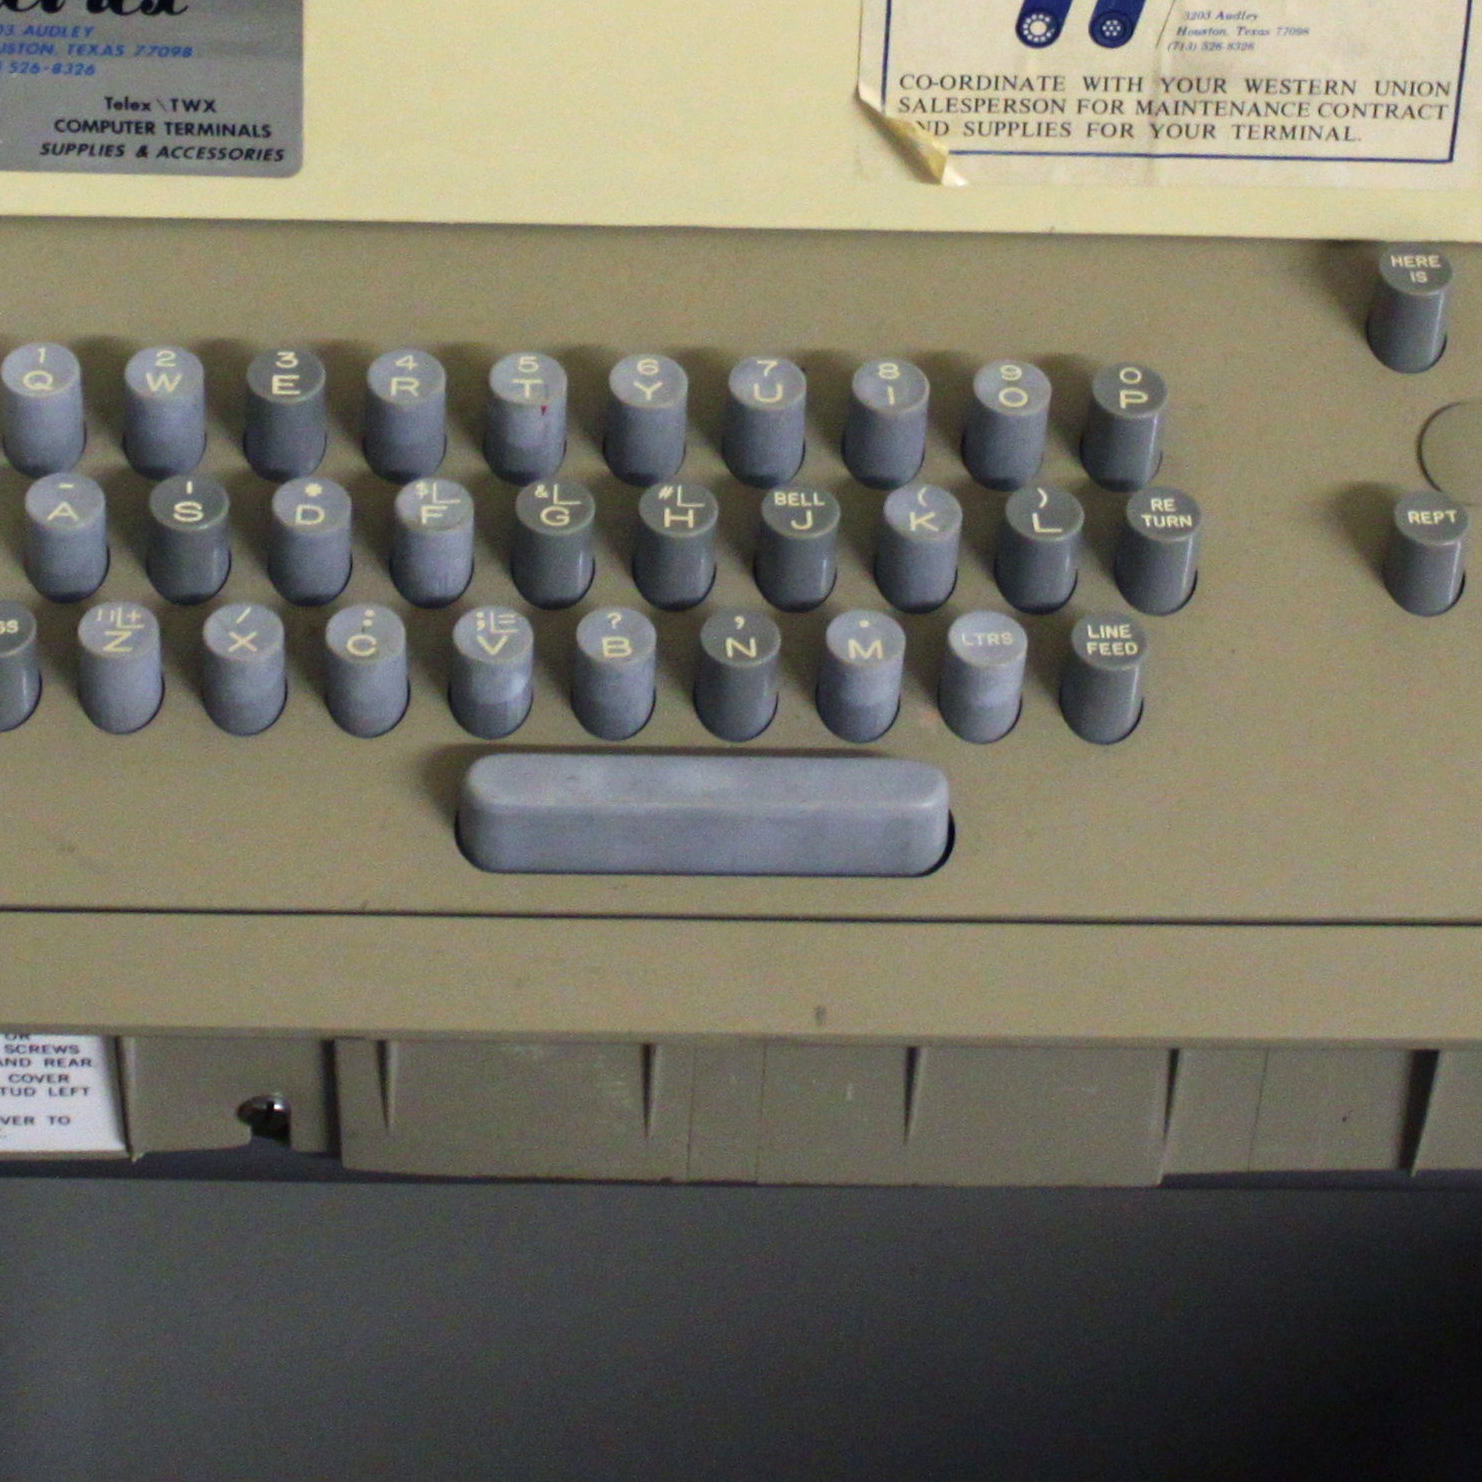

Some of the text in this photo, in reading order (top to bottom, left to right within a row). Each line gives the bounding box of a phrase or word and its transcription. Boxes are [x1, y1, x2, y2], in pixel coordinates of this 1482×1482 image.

[23, 25, 95, 39] AUDLEY
[1237, 26, 1270, 36] Texas
[68, 44, 125, 57] TEXAS
[135, 45, 193, 58] 77098
[10, 61, 95, 76] 526-8326
[899, 74, 1451, 97] CO-ORDINATE WITH YOUR WESTERN UNION
[105, 97, 152, 112] Telex
[899, 97, 1449, 119] SALESPERSON FOR MAINTENANCE CONTRACT
[55, 119, 271, 138] COMPUTER TERMINALS
[916, 120, 1362, 142] ND SUPPLIES FOR YOUR TERMINAL.
[40, 143, 284, 162] SUPPLIES & ACCESSORIES
[1391, 255, 1441, 268] HERE
[1410, 271, 1427, 283] IS
[38, 347, 46, 362] 1
[156, 351, 176, 367] 2
[276, 352, 297, 368] 3
[395, 355, 417, 370] 4
[519, 357, 538, 372] 5
[638, 359, 658, 375] 6
[757, 360, 777, 376] 7
[879, 364, 898, 379] 8
[1000, 365, 1022, 381] 9
[23, 372, 53, 389] Q
[145, 372, 182, 393] W
[272, 375, 300, 395] E
[390, 378, 420, 397] R
[513, 379, 543, 398] T
[633, 381, 663, 401] Y
[753, 384, 783, 403] U
[998, 388, 1028, 406] O
[1119, 390, 1148, 409] P
[774, 492, 824, 506] BELL
[1151, 498, 1175, 511] RE
[47, 502, 78, 521] A
[173, 502, 203, 521] S
[296, 505, 325, 525] D
[420, 506, 448, 525] F
[540, 507, 570, 526] G
[664, 509, 694, 529] H
[1407, 510, 1457, 524] REPT
[791, 511, 813, 530] J
[909, 512, 939, 531] K
[1032, 513, 1063, 533] L
[1141, 513, 1192, 528] TURN
[962, 633, 1013, 646] LTRS
[1087, 625, 1131, 639] LINE
[104, 631, 133, 653] Z
[228, 631, 258, 652] X
[346, 634, 377, 656] C
[477, 636, 508, 656] V
[601, 637, 631, 658] B
[726, 637, 757, 657] N
[848, 639, 883, 660] M
[1086, 641, 1138, 656] FEED
[4, 1044, 80, 1054] SCREWS
[44, 1058, 92, 1067] REAR
[9, 1074, 69, 1084] COVER
[48, 1087, 90, 1096] LEFT
[49, 1116, 71, 1125] TO
